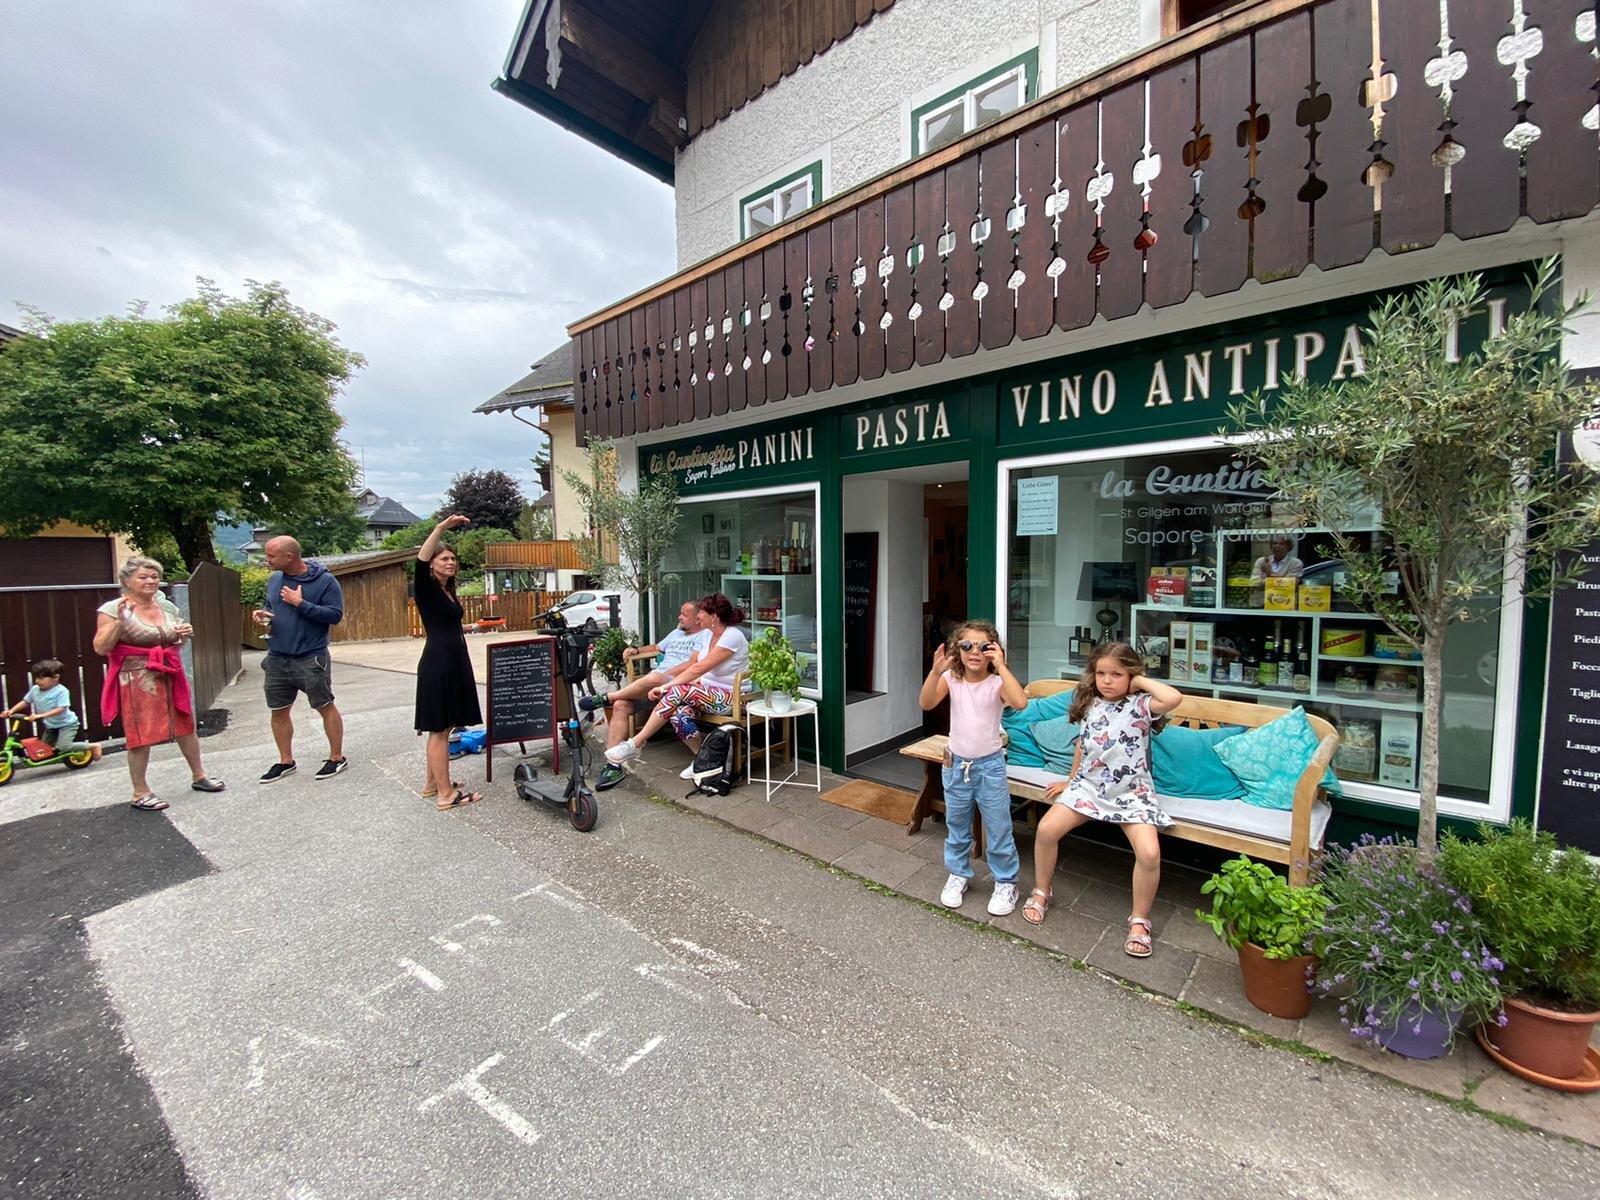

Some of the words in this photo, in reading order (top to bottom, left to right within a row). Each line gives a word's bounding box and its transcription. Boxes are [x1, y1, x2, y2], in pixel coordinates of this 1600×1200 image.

[1012, 369, 1116, 428] VINO
[1144, 298, 1508, 408] ANTIPATI
[856, 401, 950, 450] PASTA
[650, 454, 662, 474] la
[666, 444, 736, 471] Cantinetta
[739, 427, 814, 469] PANINI
[685, 469, 708, 485] Sapore
[710, 462, 736, 478] Italiano
[1100, 470, 1135, 498] la
[1146, 461, 1273, 496] Cantin
[1121, 508, 1134, 518] St.
[1137, 506, 1180, 519] Gilgen
[1184, 505, 1207, 516] am
[1212, 501, 1274, 516] Wolfgan
[1124, 526, 1204, 546] Sapore
[1211, 524, 1306, 543] Italiano
[1562, 778, 1587, 788] altre
[1572, 768, 1581, 776] vi
